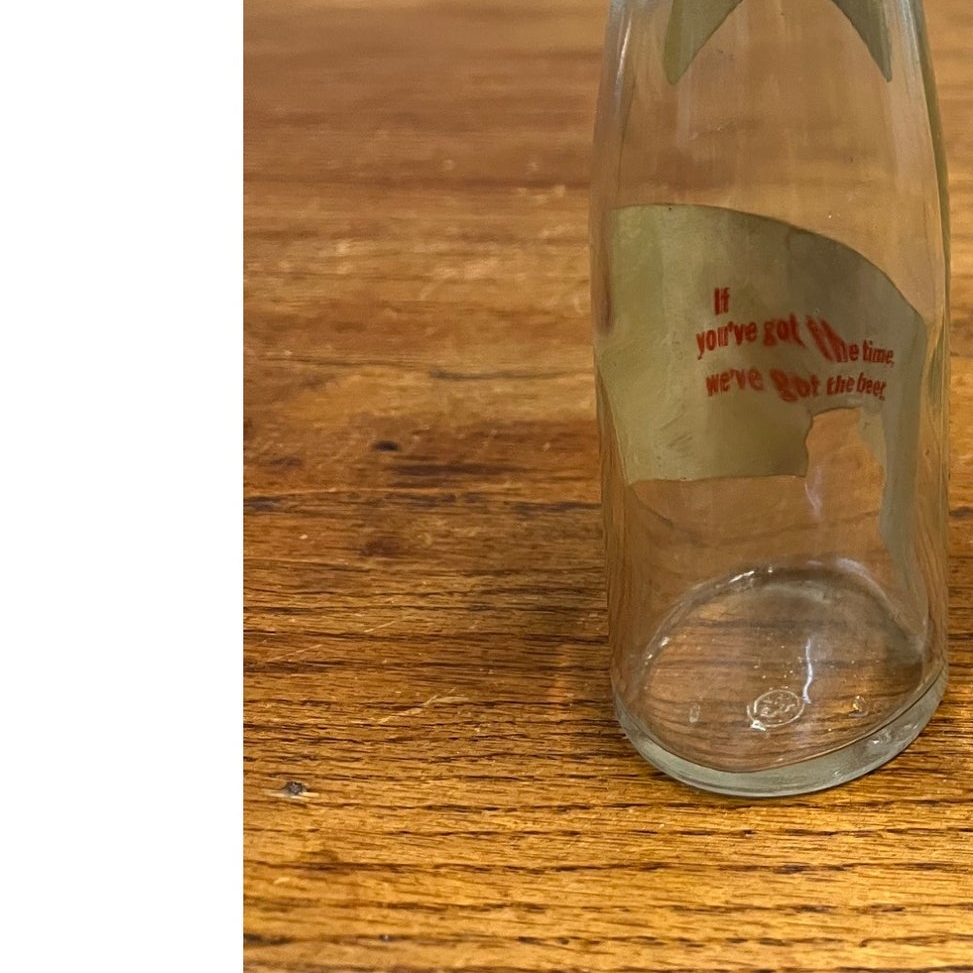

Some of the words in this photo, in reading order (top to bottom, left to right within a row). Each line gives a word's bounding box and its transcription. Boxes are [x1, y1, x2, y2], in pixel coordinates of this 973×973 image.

[714, 287, 730, 315] If
[696, 321, 757, 360] you've
[763, 312, 806, 348] got
[805, 314, 860, 363] the
[706, 368, 764, 397] we've
[770, 368, 820, 402] got
[826, 374, 855, 396] the
